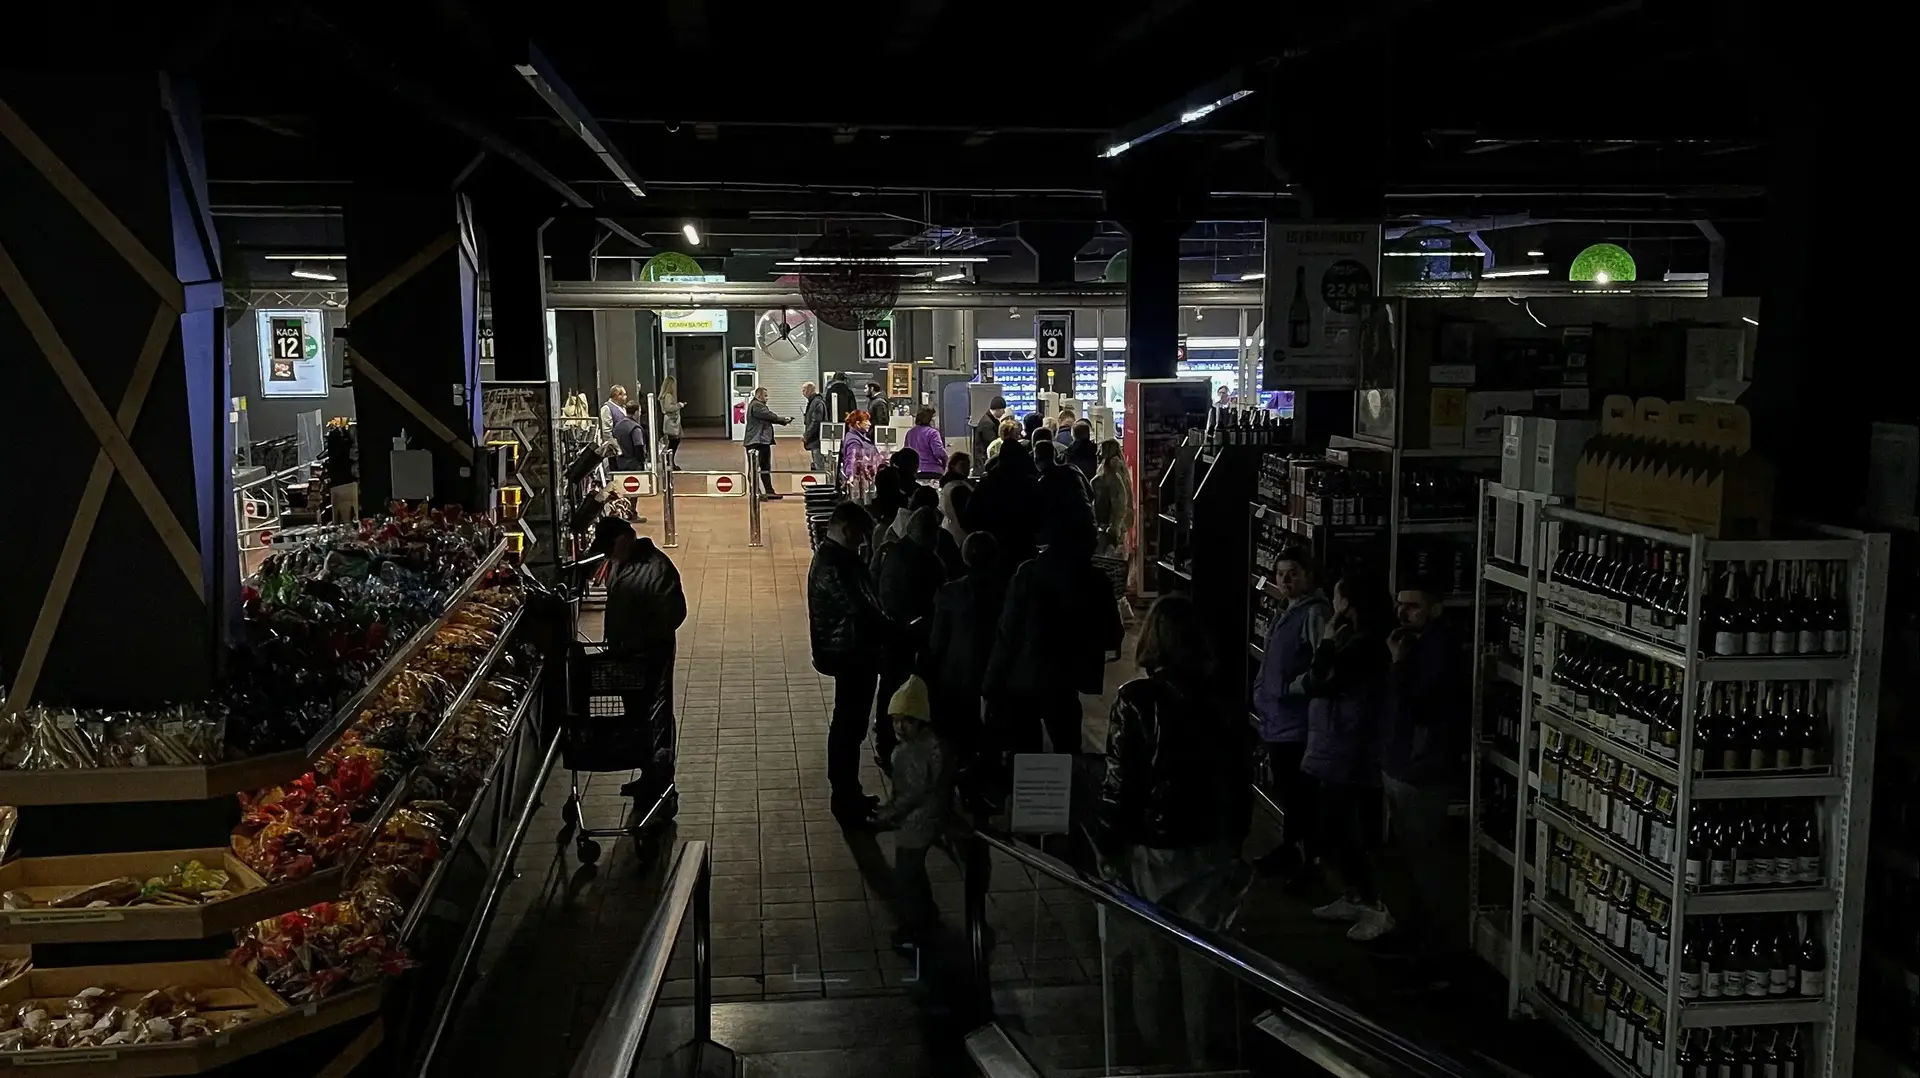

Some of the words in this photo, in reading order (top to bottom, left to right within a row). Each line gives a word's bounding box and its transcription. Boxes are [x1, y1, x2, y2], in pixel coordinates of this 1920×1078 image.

[276, 328, 300, 337] КАСА
[866, 328, 888, 337] КАСА
[1042, 328, 1063, 337] КАСА
[277, 337, 300, 358] 12
[867, 337, 887, 357] 10
[1047, 337, 1058, 357] 9
